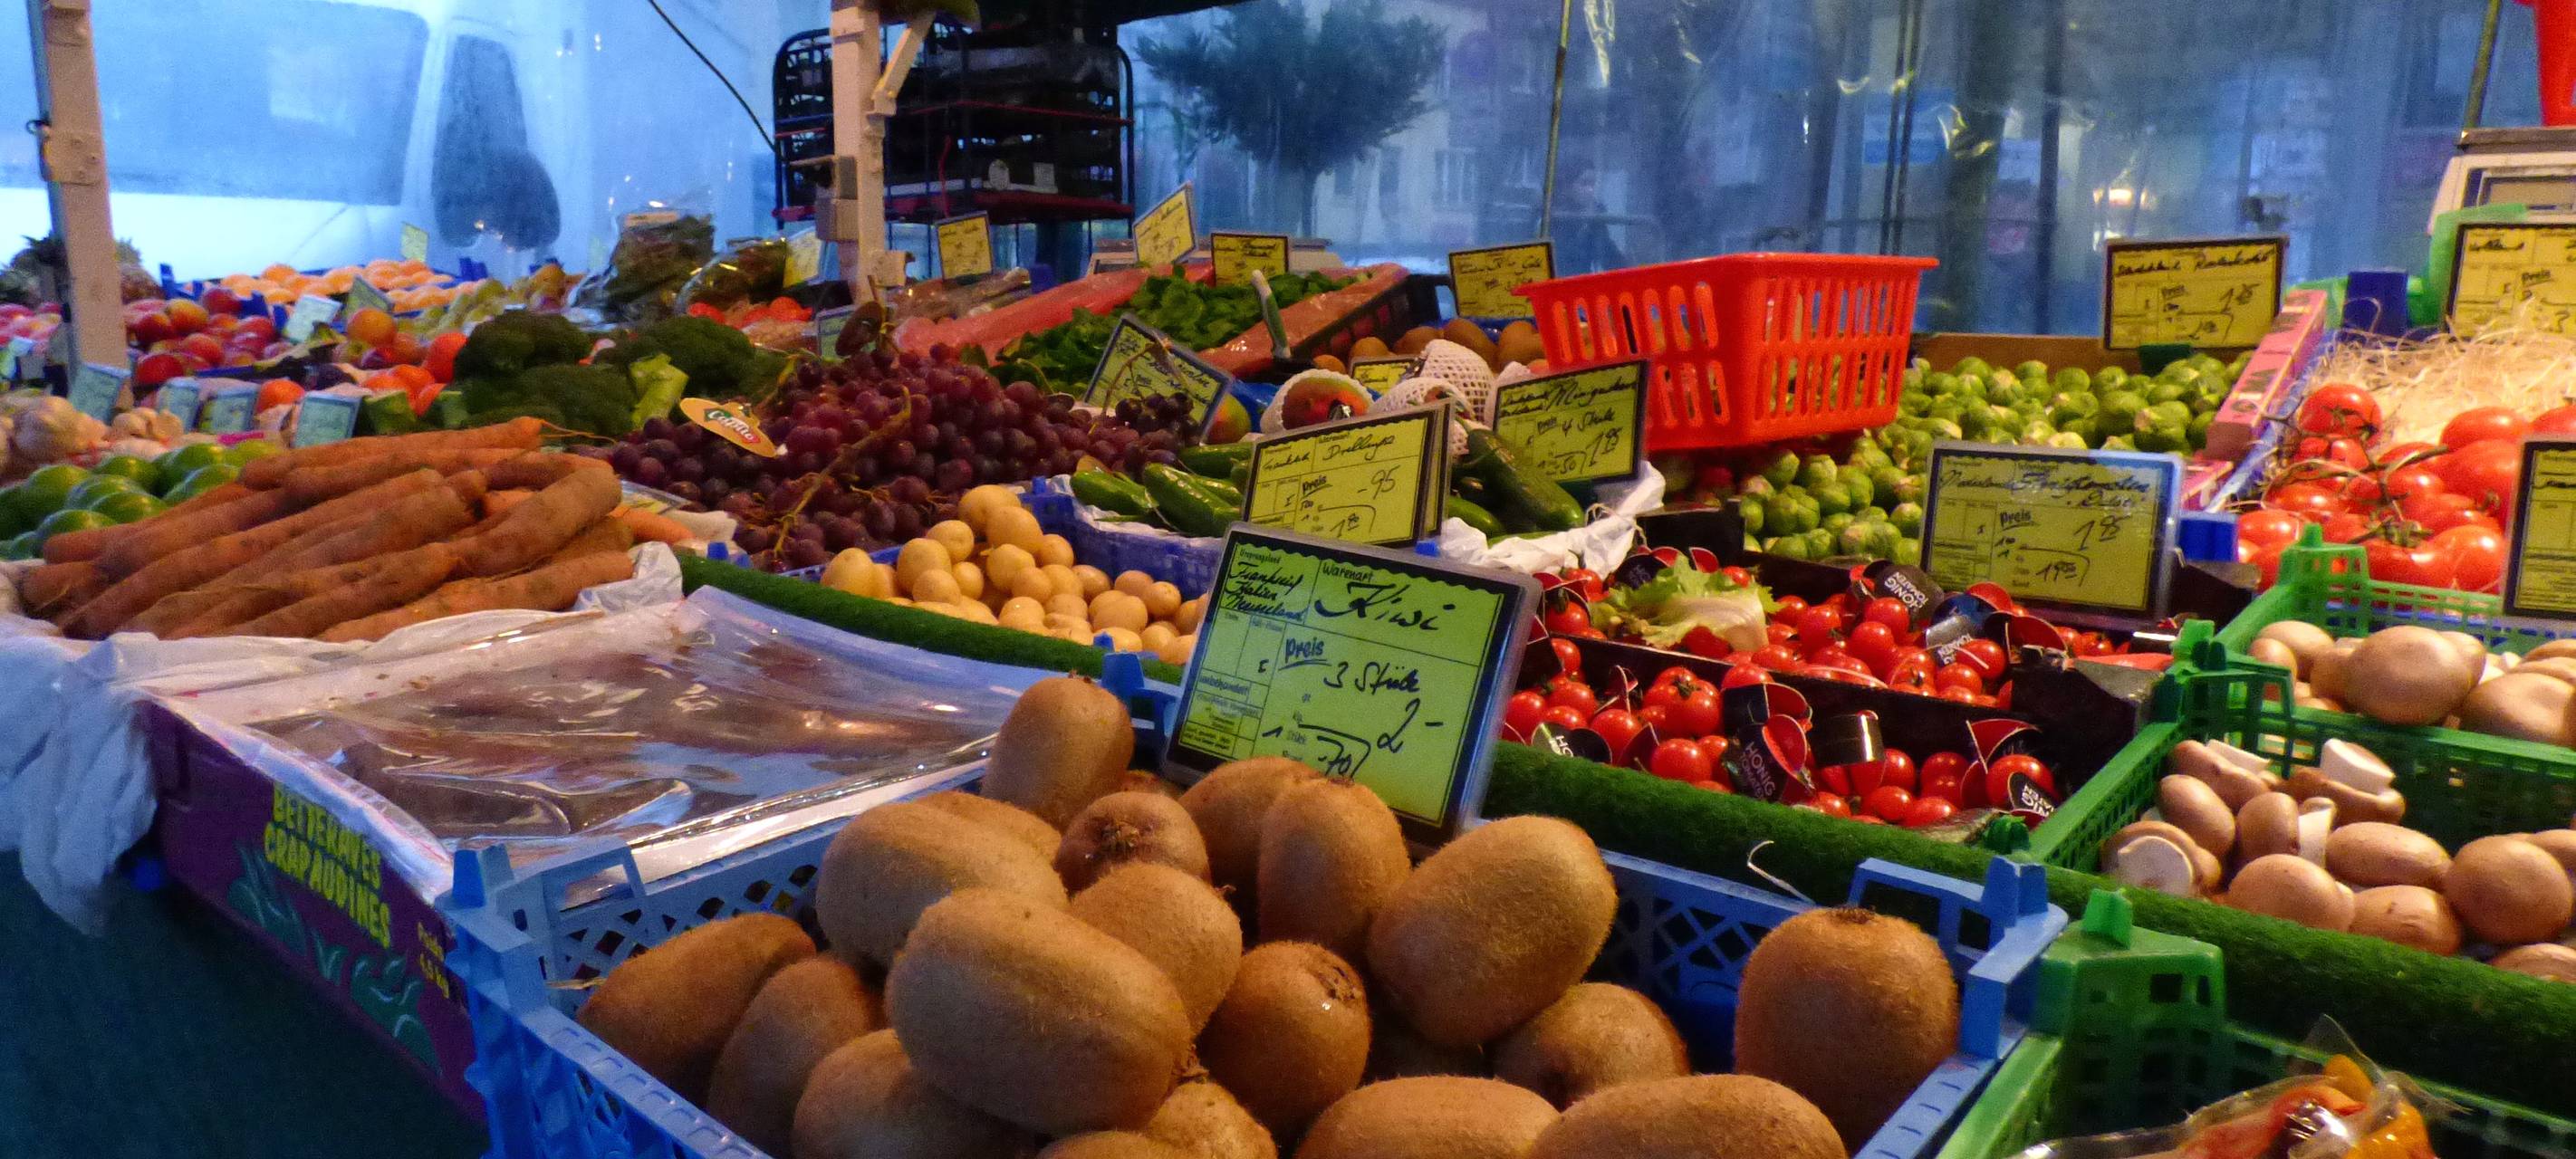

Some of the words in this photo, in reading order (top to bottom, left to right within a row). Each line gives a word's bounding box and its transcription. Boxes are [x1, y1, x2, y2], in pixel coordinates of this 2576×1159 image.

[1322, 562, 1374, 583] Warenart
[1314, 580, 1456, 632] Kiwi
[1323, 661, 1350, 689] 3
[1354, 661, 1420, 695] Stück
[1745, 741, 1776, 797] HONIG
[264, 820, 390, 951] CRAPAUDINES
